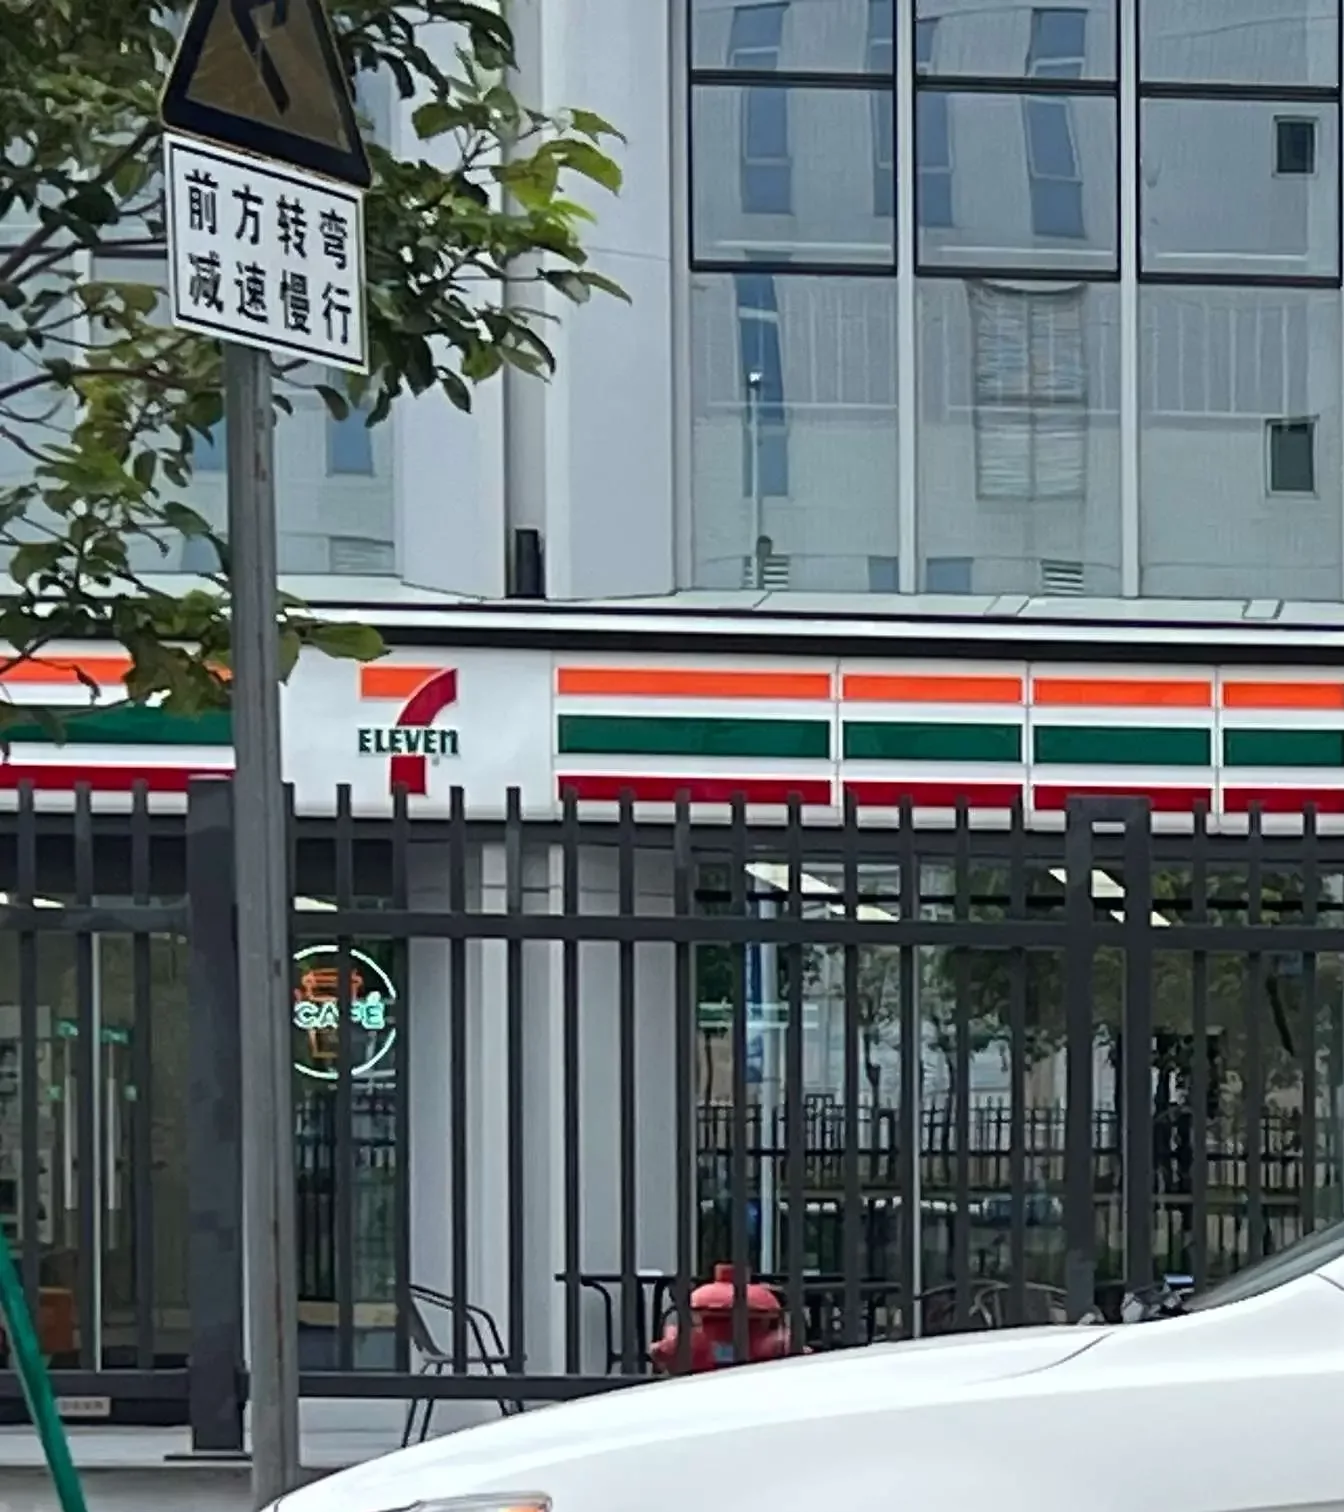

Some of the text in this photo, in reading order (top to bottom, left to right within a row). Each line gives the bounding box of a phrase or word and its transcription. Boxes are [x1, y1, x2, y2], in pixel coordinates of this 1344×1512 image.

[184, 168, 348, 271] 前方转弯
[187, 249, 352, 345] 减速慢行
[360, 666, 459, 796] 7
